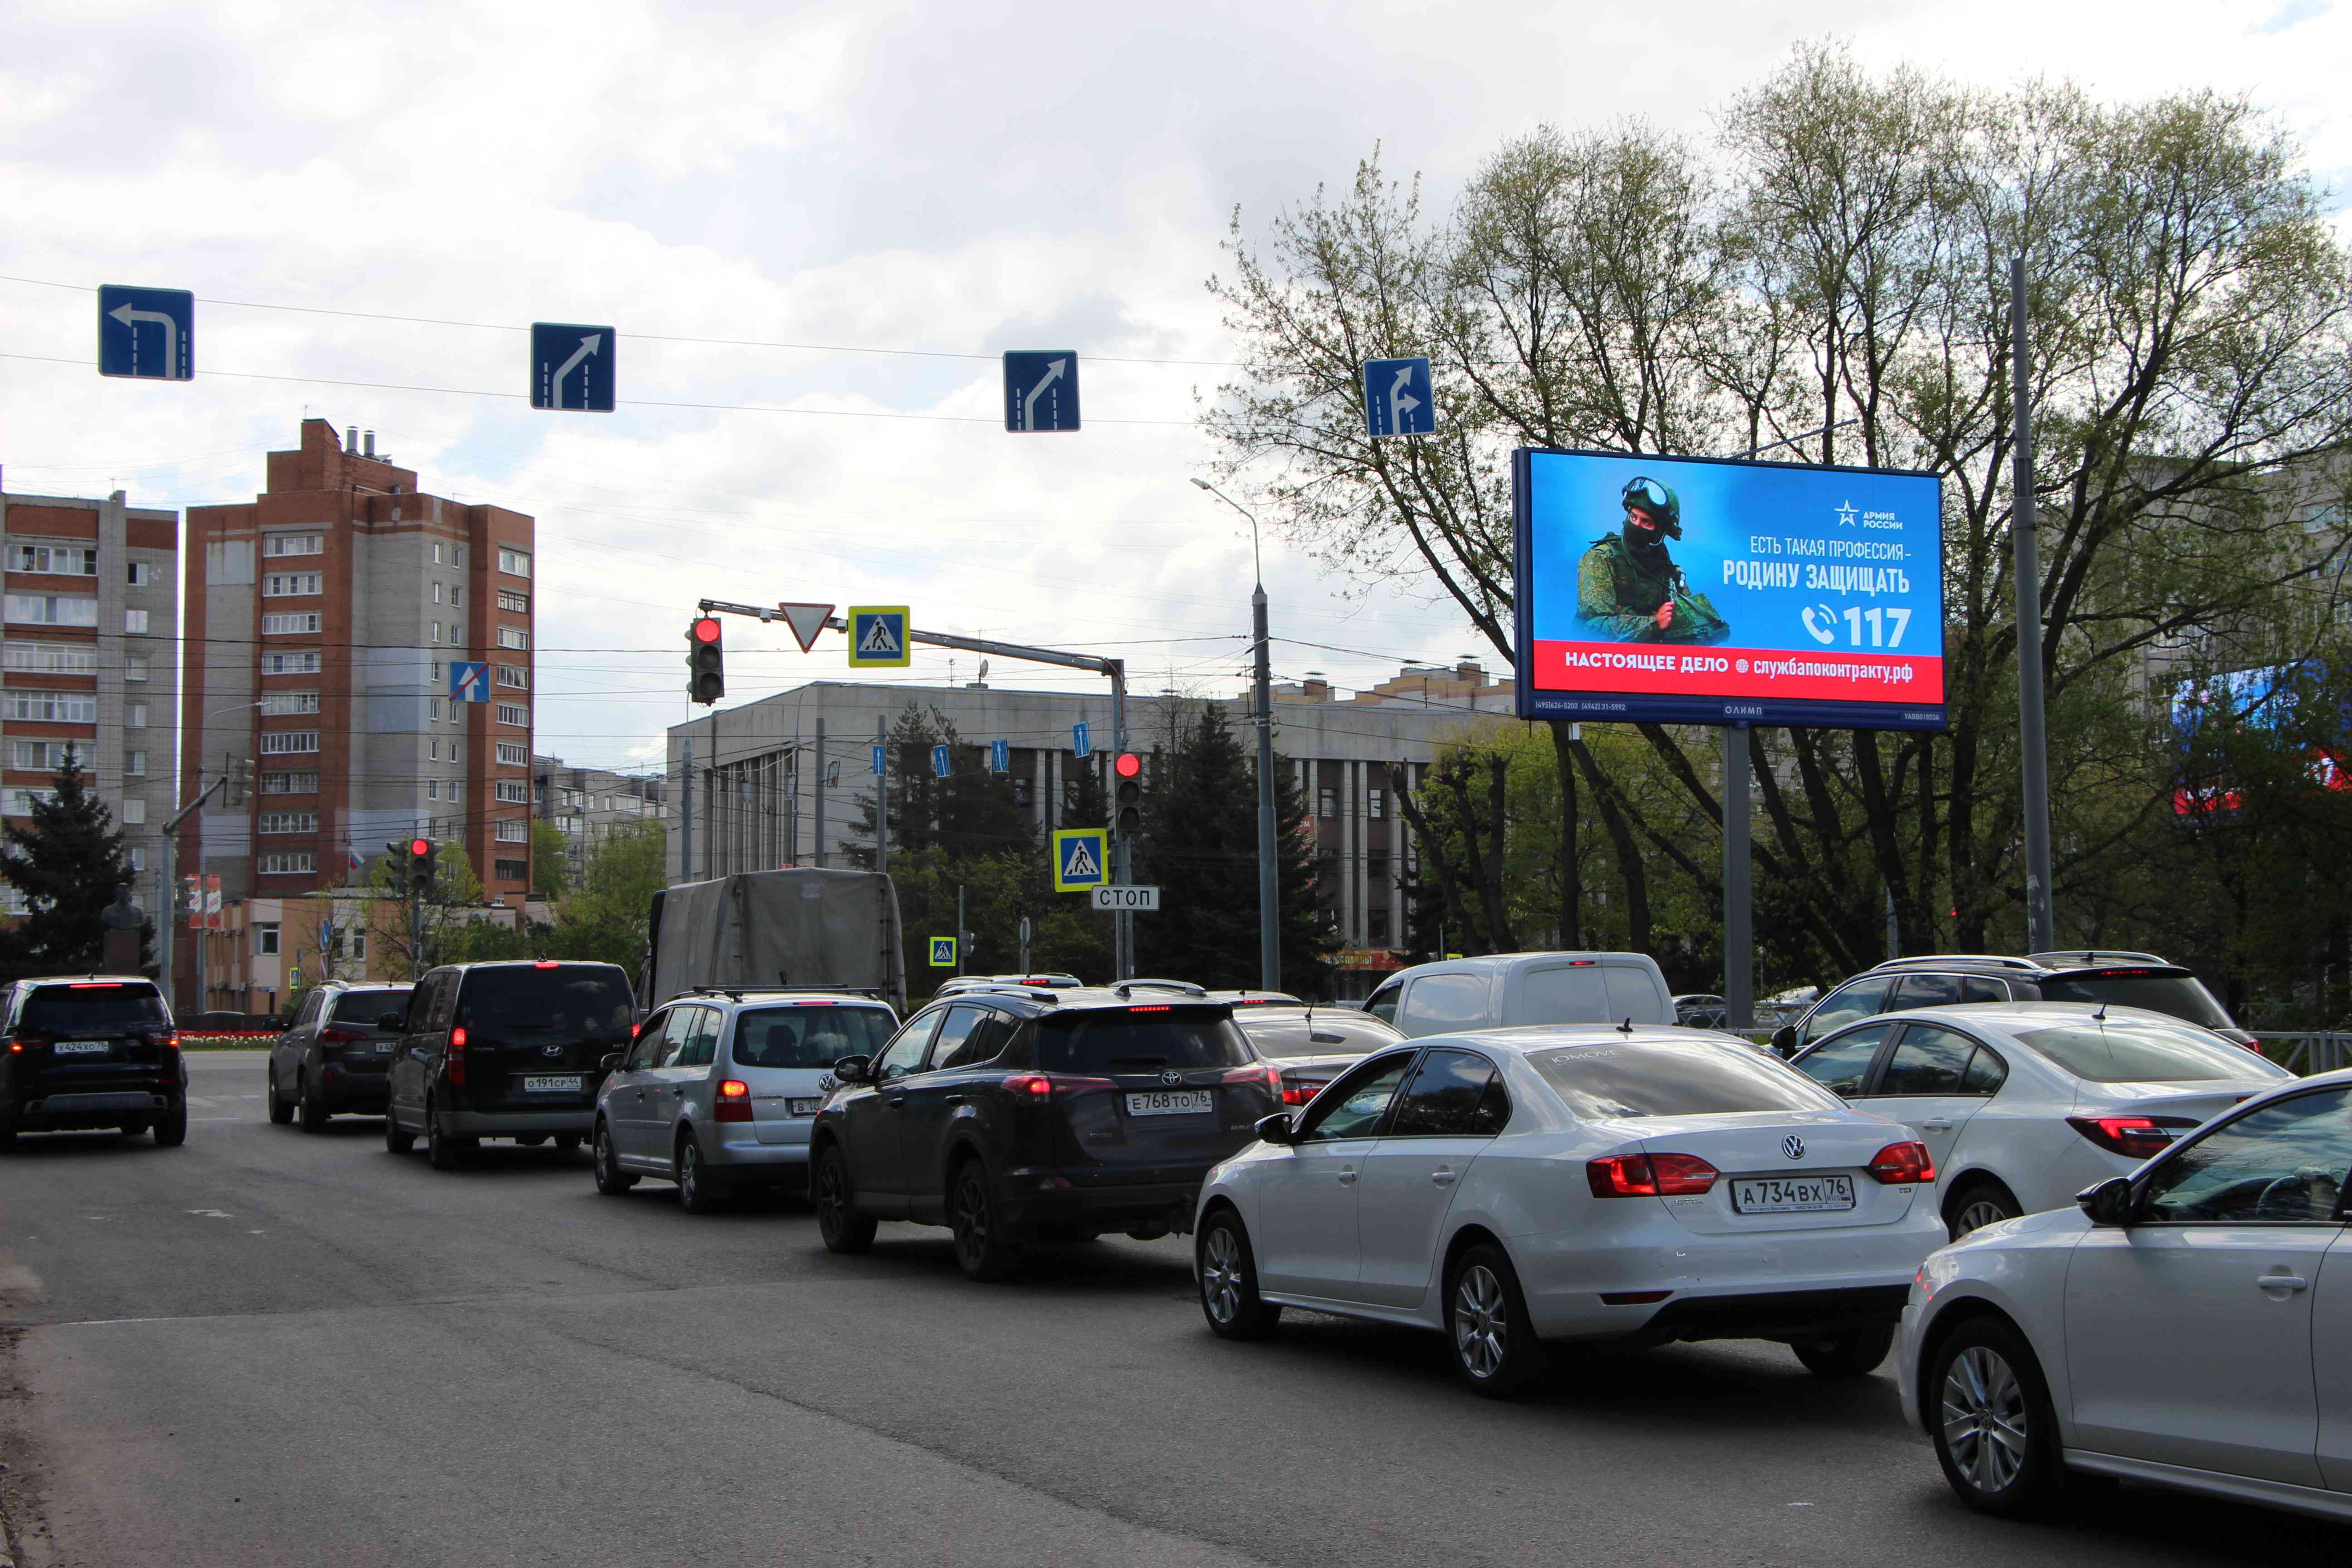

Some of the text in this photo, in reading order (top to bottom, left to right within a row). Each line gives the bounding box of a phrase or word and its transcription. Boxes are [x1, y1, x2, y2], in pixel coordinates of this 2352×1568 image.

[1863, 510, 1895, 521] АРМИЯ
[1863, 520, 1902, 530] РОССИИ
[1750, 536, 1781, 554] ЕСТЬ
[1785, 538, 1825, 557] ТАКАЯ
[1723, 560, 1910, 597] РОДИНУ ЗАЩИЩАТЬ
[1843, 606, 1911, 647] 117
[1565, 652, 1913, 684] НАСТОЯЩЕЕ ДЕЛО службапоконтракту.рф
[1725, 706, 1762, 715] ОЛИМП
[1100, 889, 1150, 906] СТОП
[1193, 1091, 1207, 1102] 76
[1826, 1179, 1846, 1195] 76
